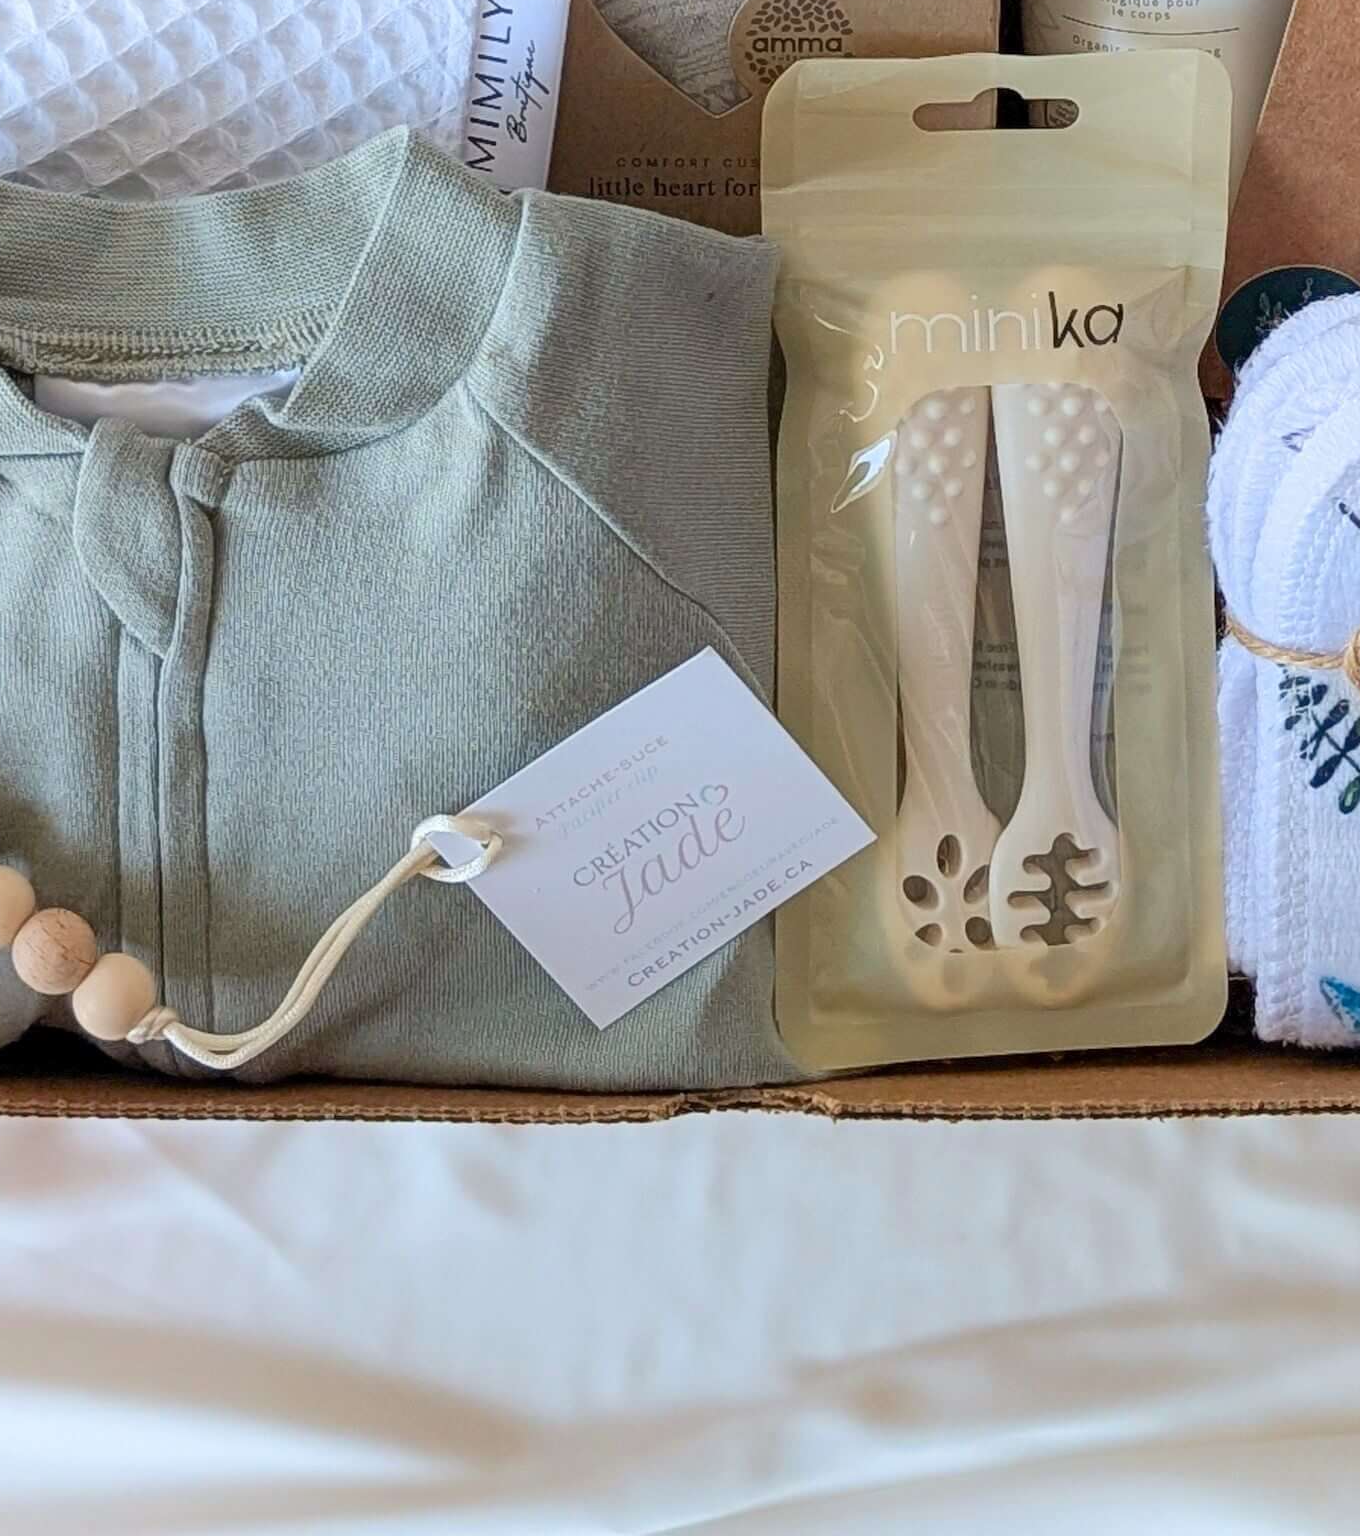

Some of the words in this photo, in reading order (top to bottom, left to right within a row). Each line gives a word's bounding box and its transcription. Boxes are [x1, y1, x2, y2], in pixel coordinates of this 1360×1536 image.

[751, 37, 843, 53] amma
[1111, 5, 1125, 18] le
[1130, 8, 1172, 23] corps
[589, 176, 645, 197] little
[652, 176, 718, 197] heart
[723, 177, 758, 197] for
[615, 156, 710, 168] COMFORT
[889, 290, 1125, 354] minika
[534, 734, 670, 832] ATTACHE-SUCE
[572, 791, 700, 888] CRÉATION
[601, 807, 747, 935] Jade
[626, 858, 814, 989] CREATION-JADE.CA
